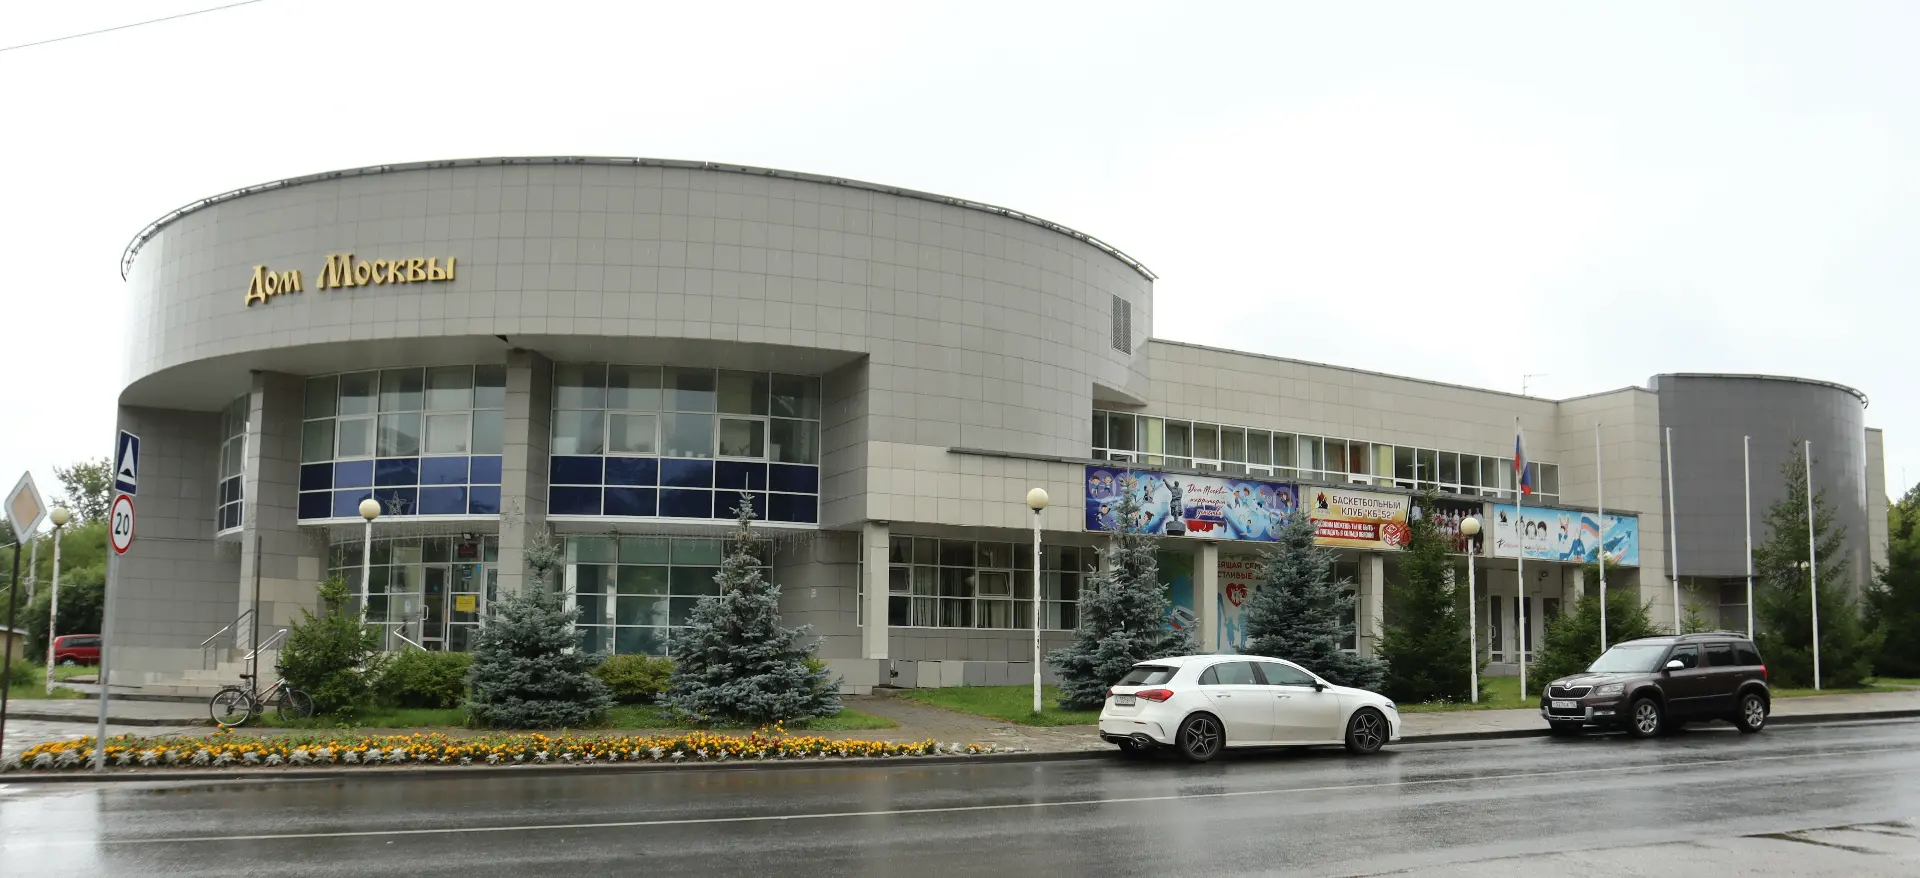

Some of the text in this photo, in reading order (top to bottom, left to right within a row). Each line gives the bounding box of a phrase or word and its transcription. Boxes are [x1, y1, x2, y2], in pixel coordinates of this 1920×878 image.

[244, 252, 457, 307] Дом Москвы
[1332, 495, 1401, 510] БАСКЕТБОЛЬНЫЙ
[1341, 507, 1363, 517] КЛУБ
[114, 512, 130, 536] 20
